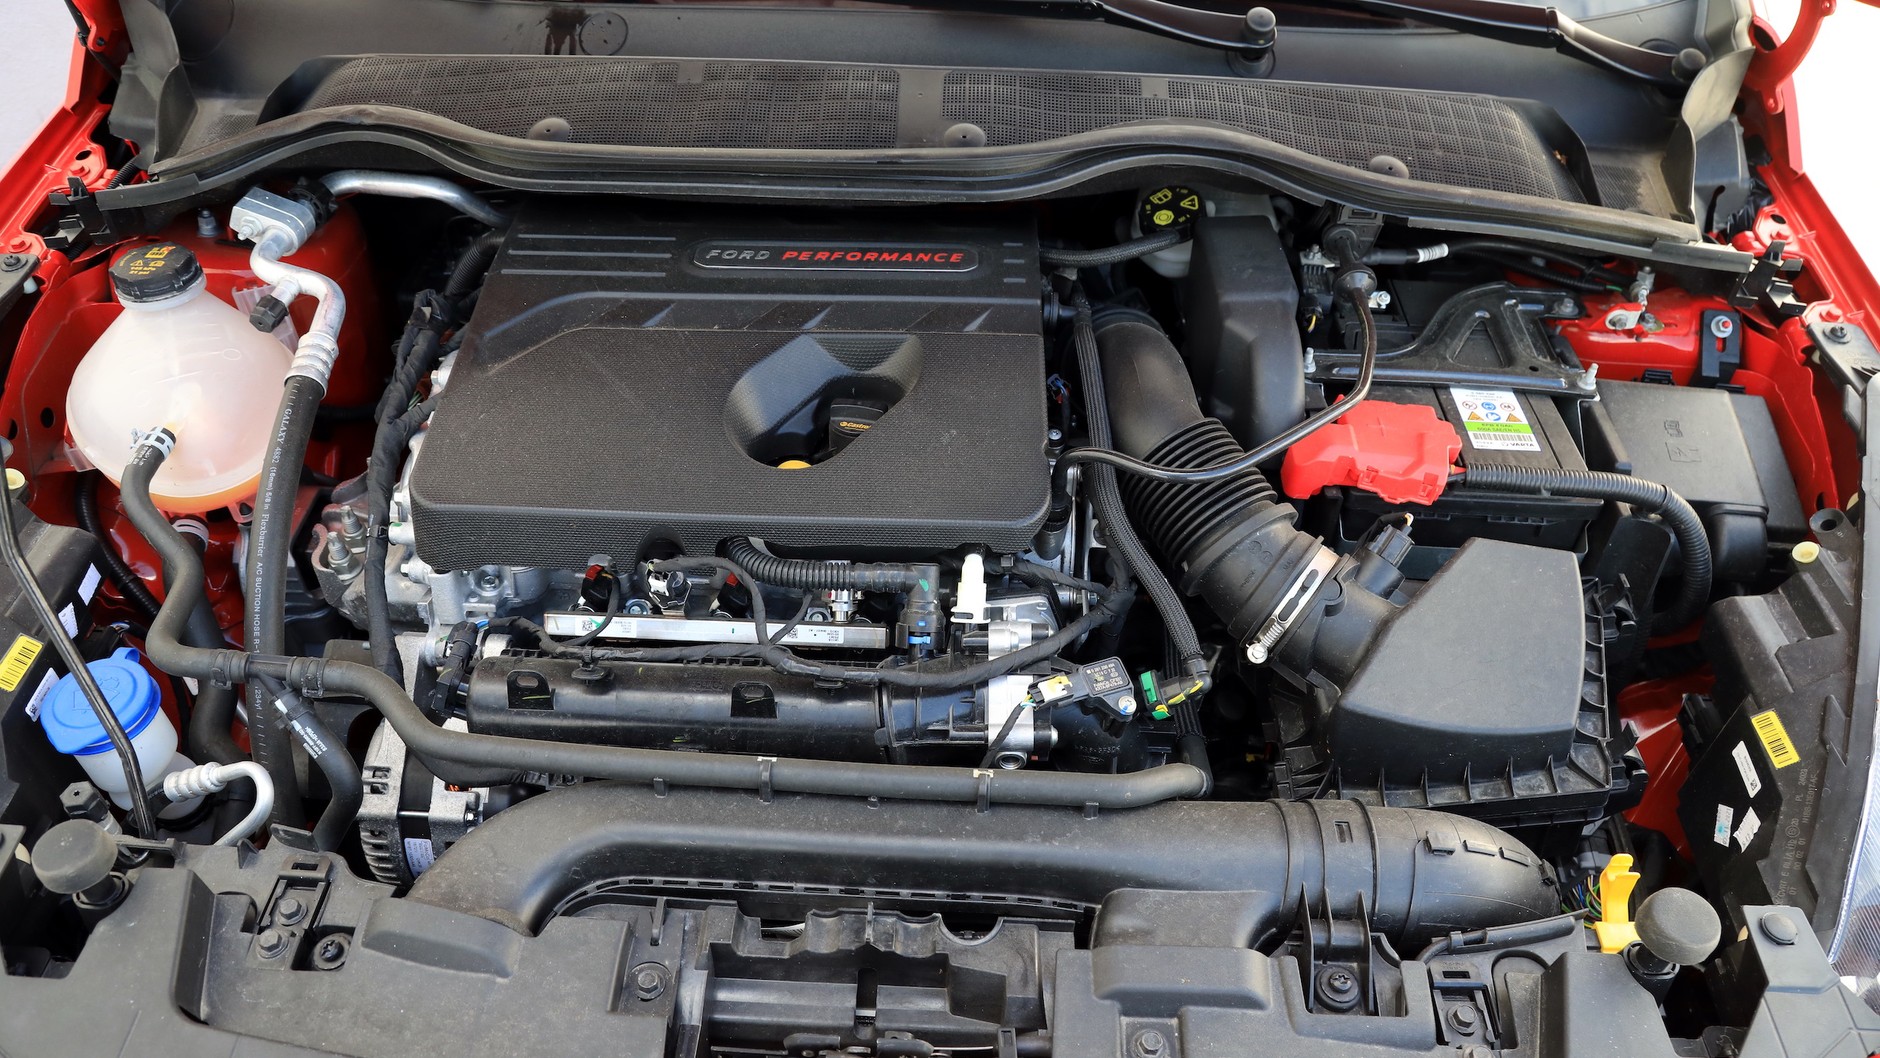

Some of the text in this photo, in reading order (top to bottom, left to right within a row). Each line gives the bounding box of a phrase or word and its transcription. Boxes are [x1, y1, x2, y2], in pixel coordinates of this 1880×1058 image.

[705, 249, 965, 263] FORD PERFORMANCE
[276, 407, 293, 445] GALAXY
[256, 513, 271, 558] Flexbarrier
[255, 561, 264, 575] A/C
[253, 577, 263, 613] SUCTION
[252, 612, 261, 637] HOSE
